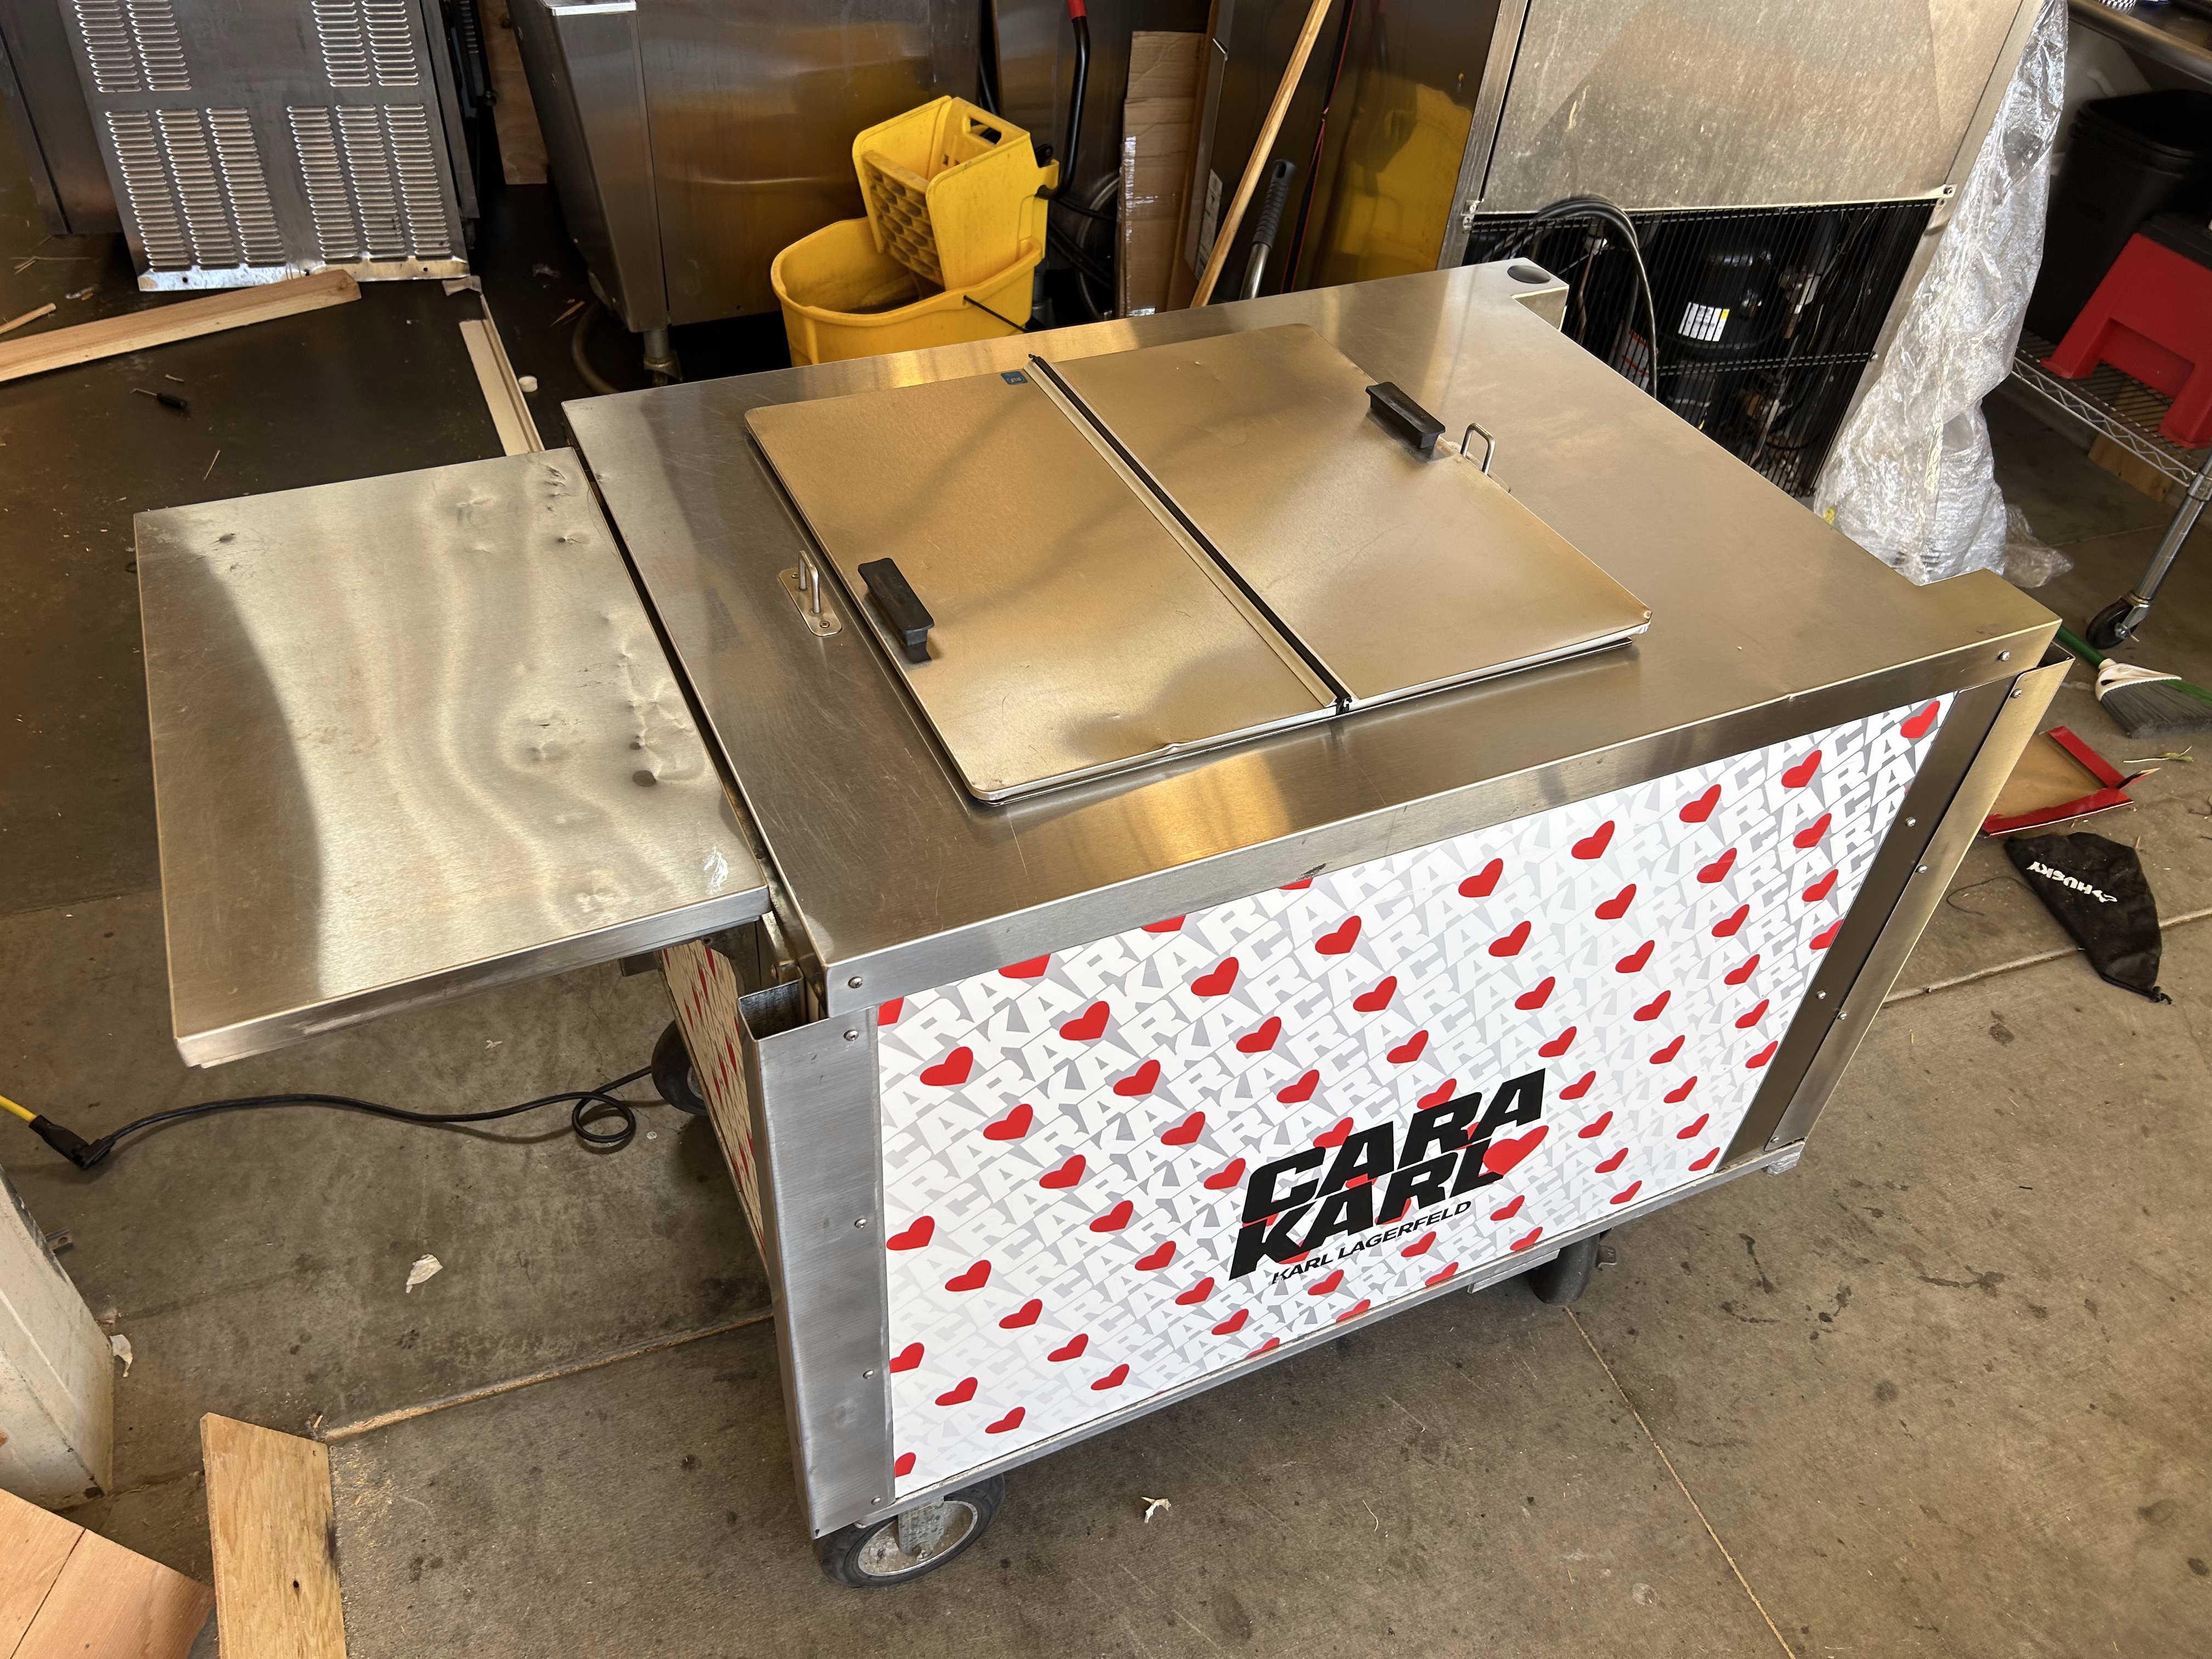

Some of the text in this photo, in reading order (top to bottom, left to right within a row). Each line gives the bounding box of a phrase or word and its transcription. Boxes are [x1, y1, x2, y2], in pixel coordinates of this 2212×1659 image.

[1450, 960, 1630, 1093] CARA
[1649, 834, 1814, 959] KARL
[1571, 787, 1908, 1043] KARL CARA
[1666, 889, 1822, 1007] KARL
[2025, 861, 2093, 895] HUSKY
[883, 1029, 1090, 1189] CARA
[1097, 884, 1312, 1026] KARL
[915, 1223, 1115, 1356] CARA
[1121, 1092, 1308, 1216] KARL
[1312, 943, 1508, 1087] CARA
[1525, 808, 1706, 943] KARL
[922, 1085, 1141, 1234] CARA
[1148, 940, 1351, 1081] KARL
[957, 925, 1182, 1072] KARL
[968, 1262, 1158, 1388] CARA
[1346, 997, 1532, 1132] CARA
[1549, 868, 1720, 995] KARL
[1734, 725, 1911, 870] CARA
[980, 1135, 1186, 1275] CARA
[1194, 998, 1385, 1130] KARL
[1390, 844, 1591, 996] CARA
[1019, 983, 1229, 1126] KARL
[1032, 1180, 1226, 1312] CARA
[1235, 1051, 1416, 1174] KARL
[1422, 905, 1612, 1047] CARA
[1631, 772, 1805, 906] KARL
[1073, 1040, 1271, 1173] KARL
[1273, 883, 1481, 1037] CARA
[1590, 974, 1745, 1086] KARL
[1680, 940, 1829, 1051] KARL
[1229, 1138, 1504, 1281] KARL
[1242, 1068, 1546, 1224] CARA
[1271, 1201, 1472, 1285] KARL LAGERFELD
[1274, 1251, 1426, 1345] KARL
[1431, 1130, 1592, 1245] CARA
[1607, 1019, 1756, 1126] KARL
[1365, 1215, 1513, 1308] KARL
[1520, 1095, 1676, 1209] CARA
[1454, 1166, 1608, 1273] CARA
[1624, 1061, 1765, 1162] KARL
[1539, 1132, 1689, 1239] CARA
[906, 1220, 1263, 1460] KARL CARA
[1017, 1297, 1197, 1417] CARA
[1121, 1256, 1296, 1374] CARA
